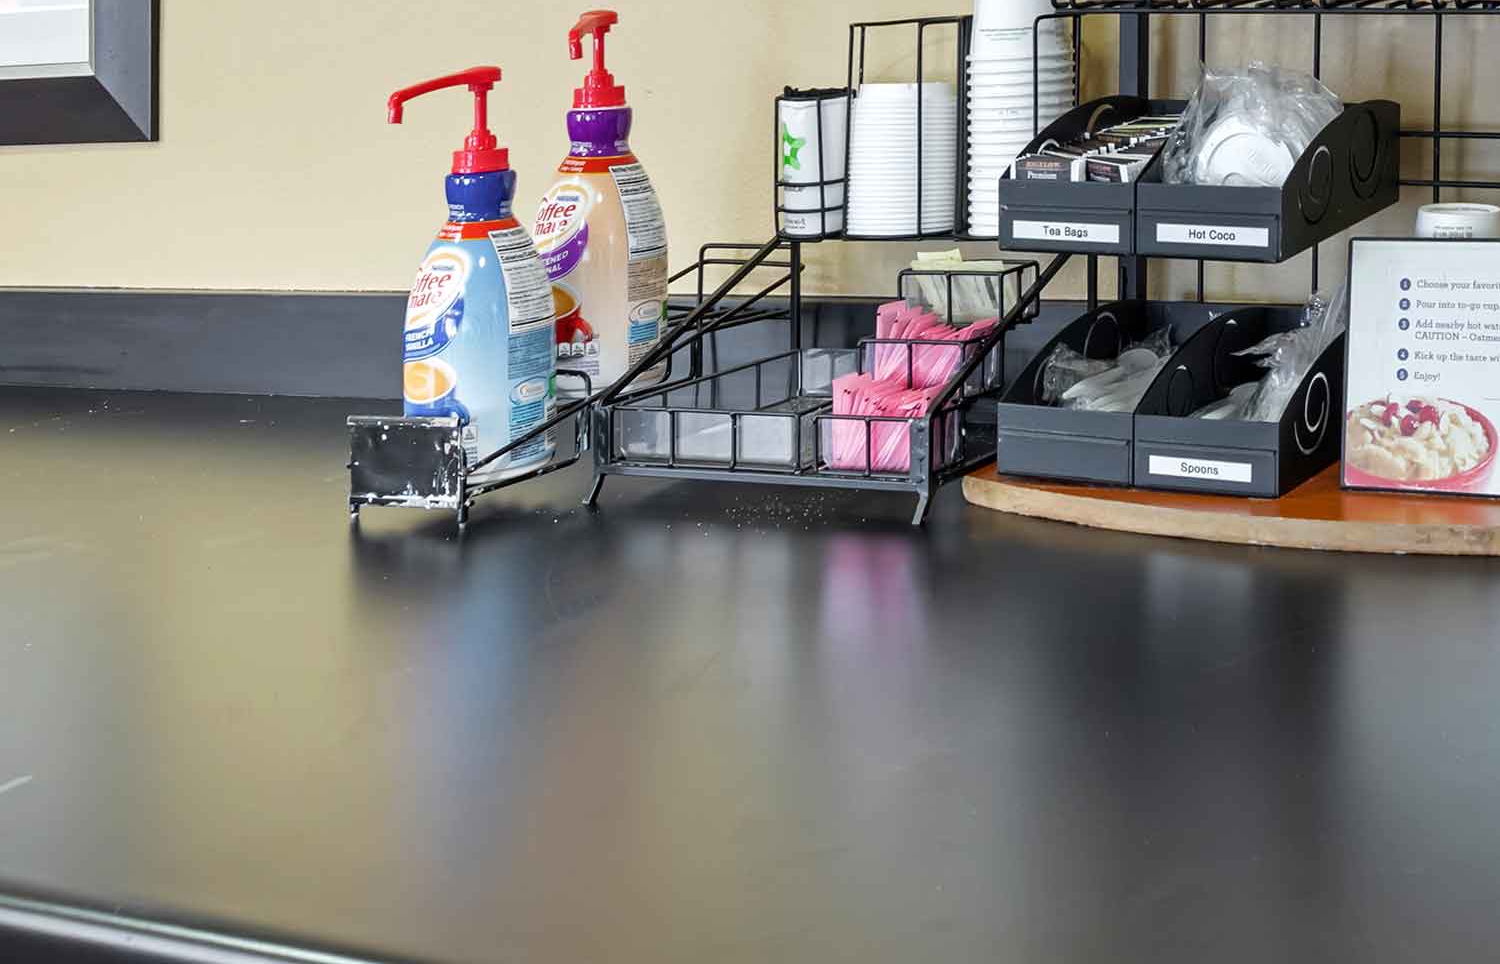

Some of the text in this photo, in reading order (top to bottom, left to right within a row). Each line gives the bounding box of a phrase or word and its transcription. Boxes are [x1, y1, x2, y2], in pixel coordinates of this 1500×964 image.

[1043, 225, 1088, 238] Tea Bags
[1189, 229, 1206, 240] Hot
[1416, 280, 1448, 289] Choose
[1450, 282, 1471, 292] your
[1416, 300, 1436, 309] Pour
[1438, 300, 1456, 309] into
[1457, 301, 1481, 311] to-go
[1415, 320, 1433, 329] Add
[1435, 321, 1465, 332] nearby
[1467, 321, 1481, 330] hot
[1415, 331, 1460, 341] CAUTION
[1414, 351, 1434, 361] Kick
[1436, 353, 1447, 363] up
[1449, 352, 1463, 361] the
[1465, 353, 1487, 363] taste
[1180, 462, 1219, 475] Spoons
